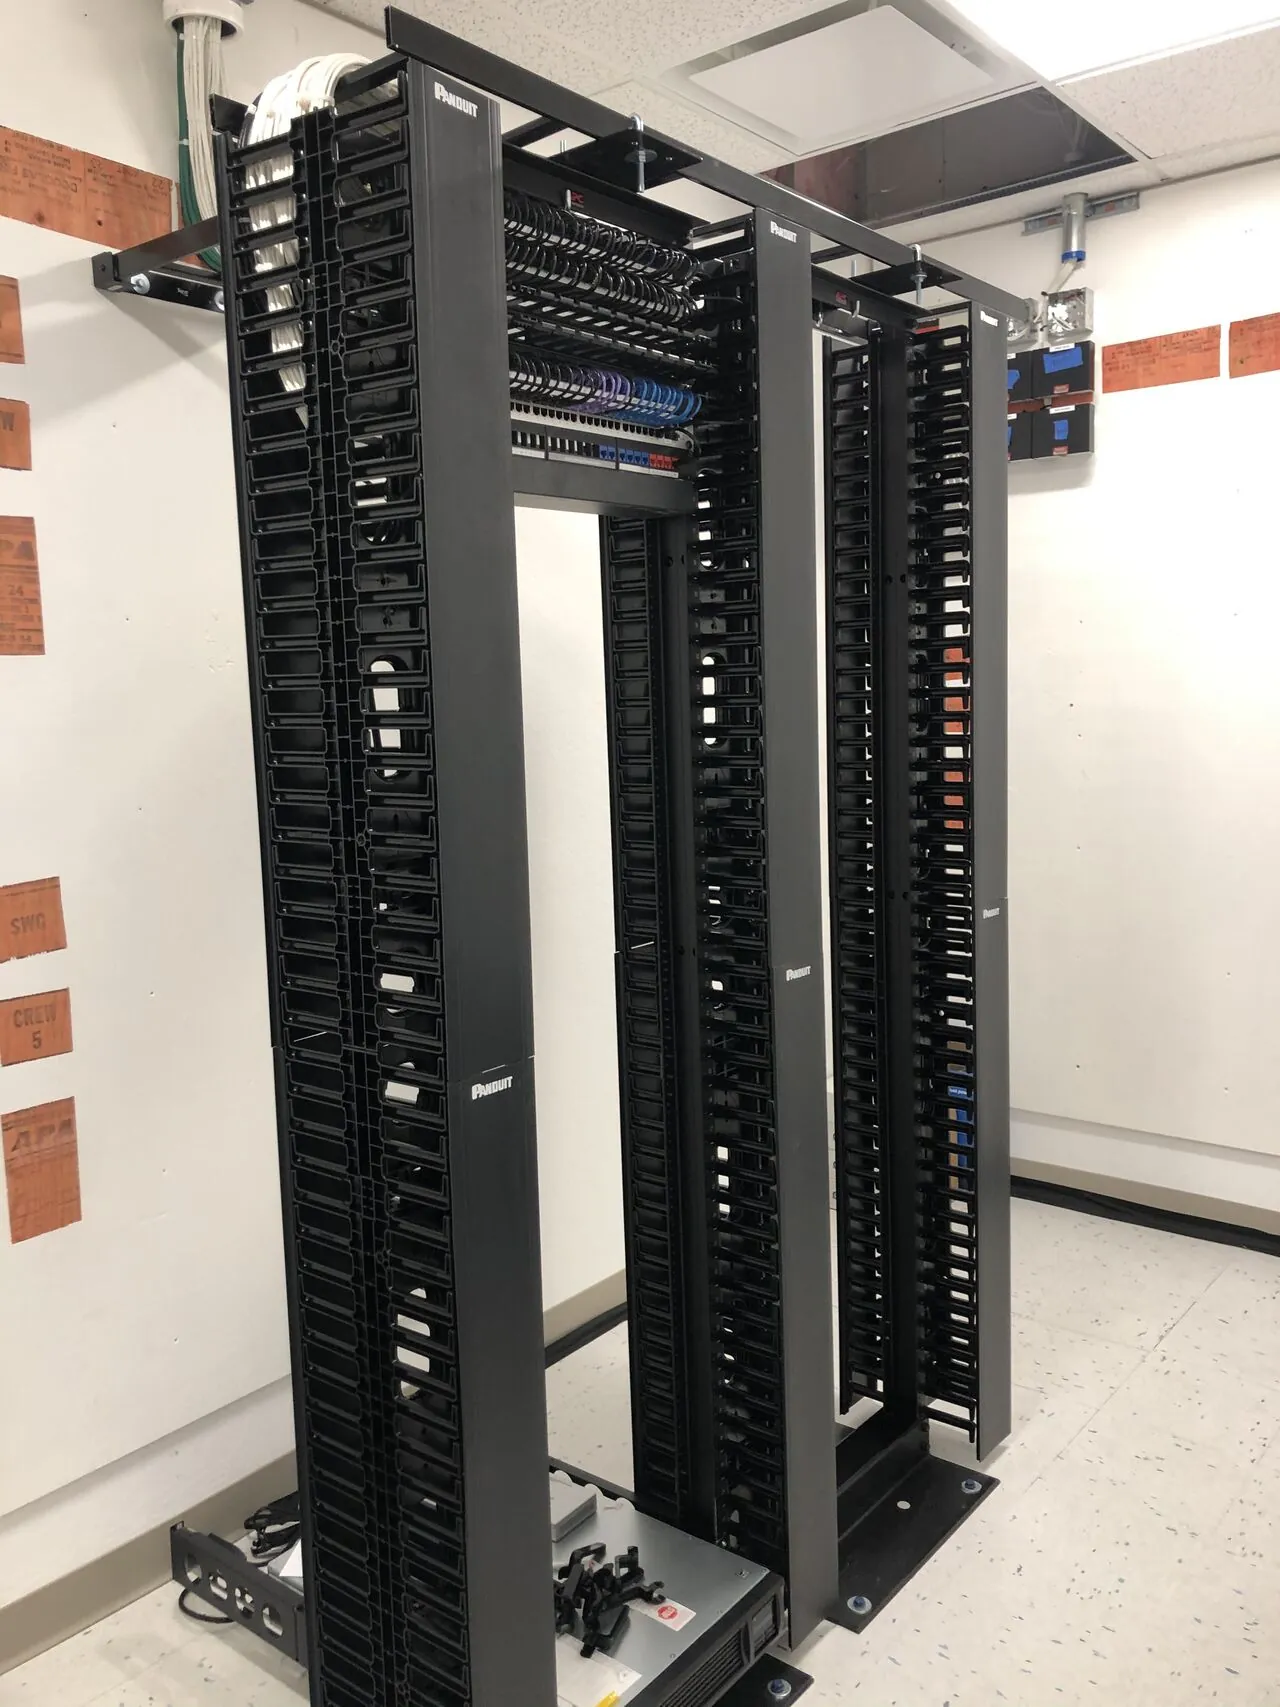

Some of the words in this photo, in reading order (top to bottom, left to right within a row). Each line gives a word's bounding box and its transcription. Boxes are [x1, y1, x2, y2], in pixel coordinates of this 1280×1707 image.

[434, 81, 478, 118] PANDUIT
[13, 1003, 57, 1029] CREW
[32, 1030, 42, 1049] 5
[471, 1075, 513, 1100] PANDUIT
